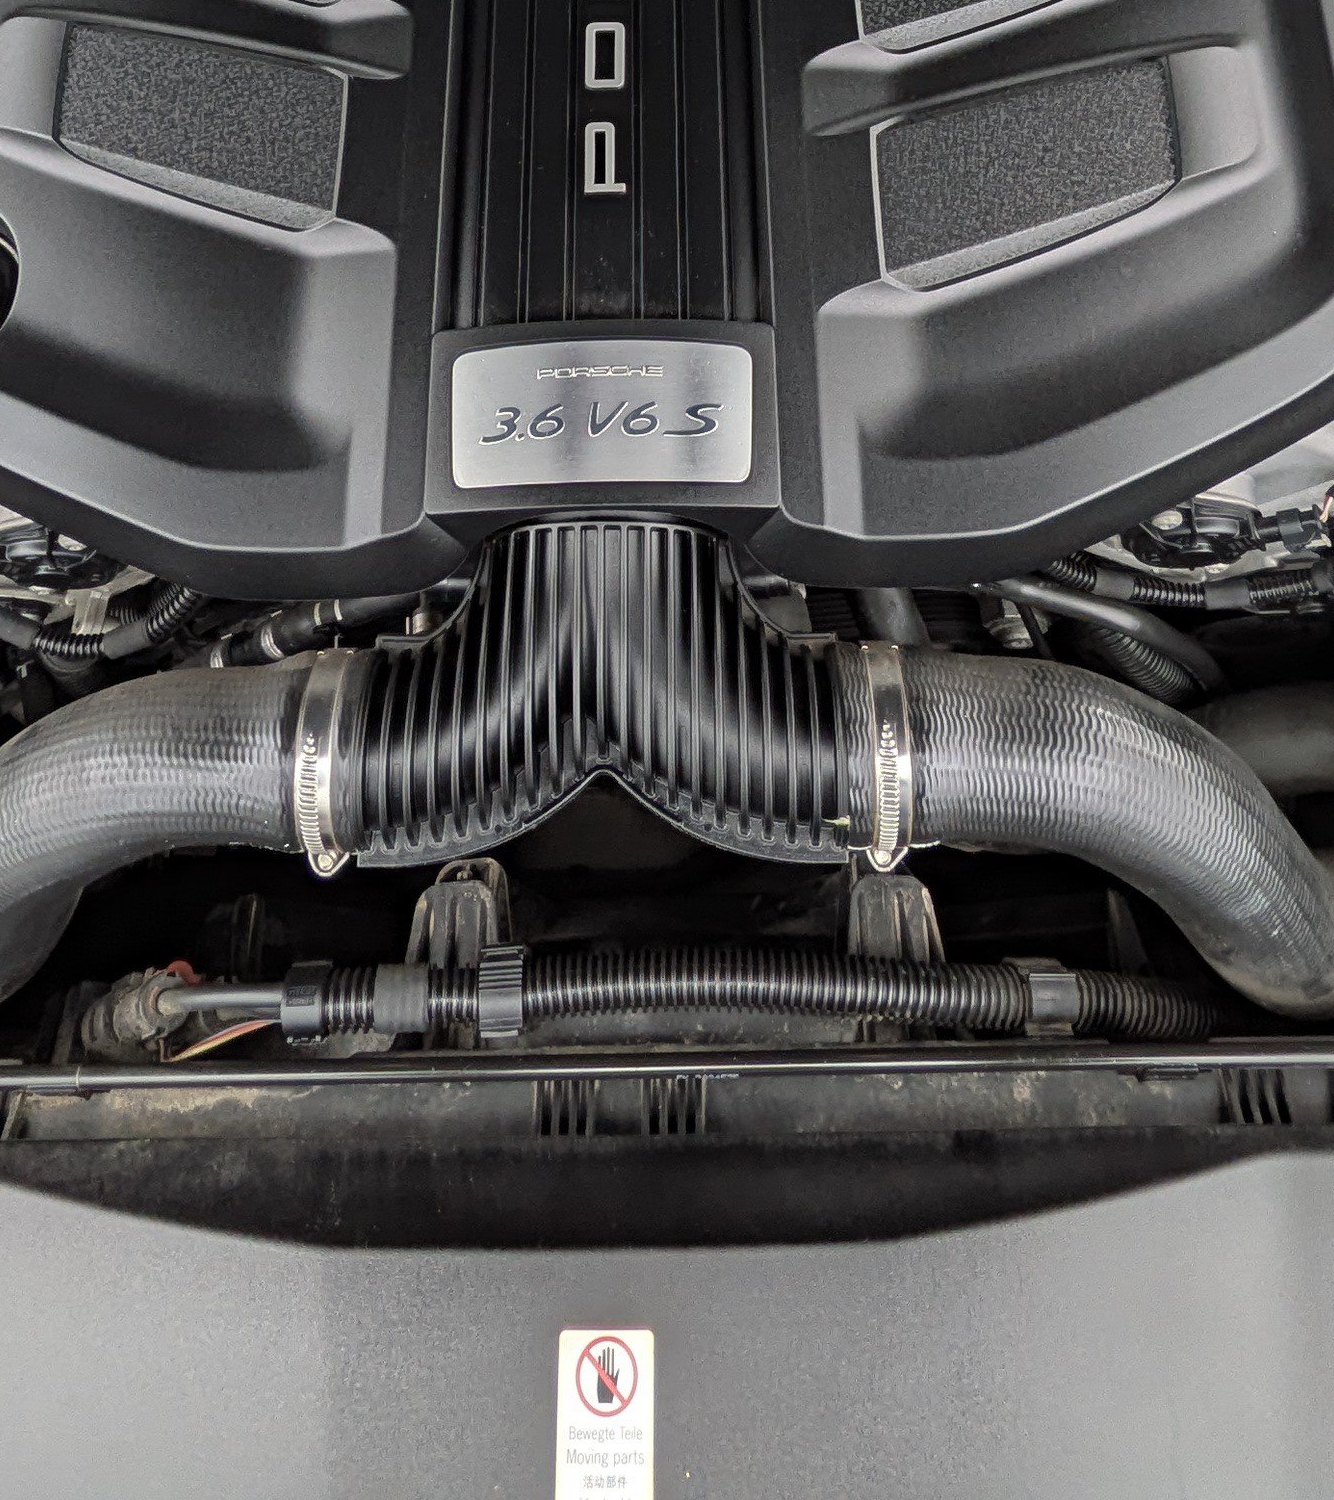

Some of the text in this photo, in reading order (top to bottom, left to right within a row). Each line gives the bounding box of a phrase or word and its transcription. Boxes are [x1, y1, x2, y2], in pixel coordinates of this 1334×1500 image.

[536, 365, 663, 380] PORSCHE
[478, 401, 725, 445] 3.6 V6 S
[569, 1426, 643, 1443] Bewegte Teile
[566, 1448, 645, 1468] Moving parts
[583, 1474, 628, 1489] 活动部件
